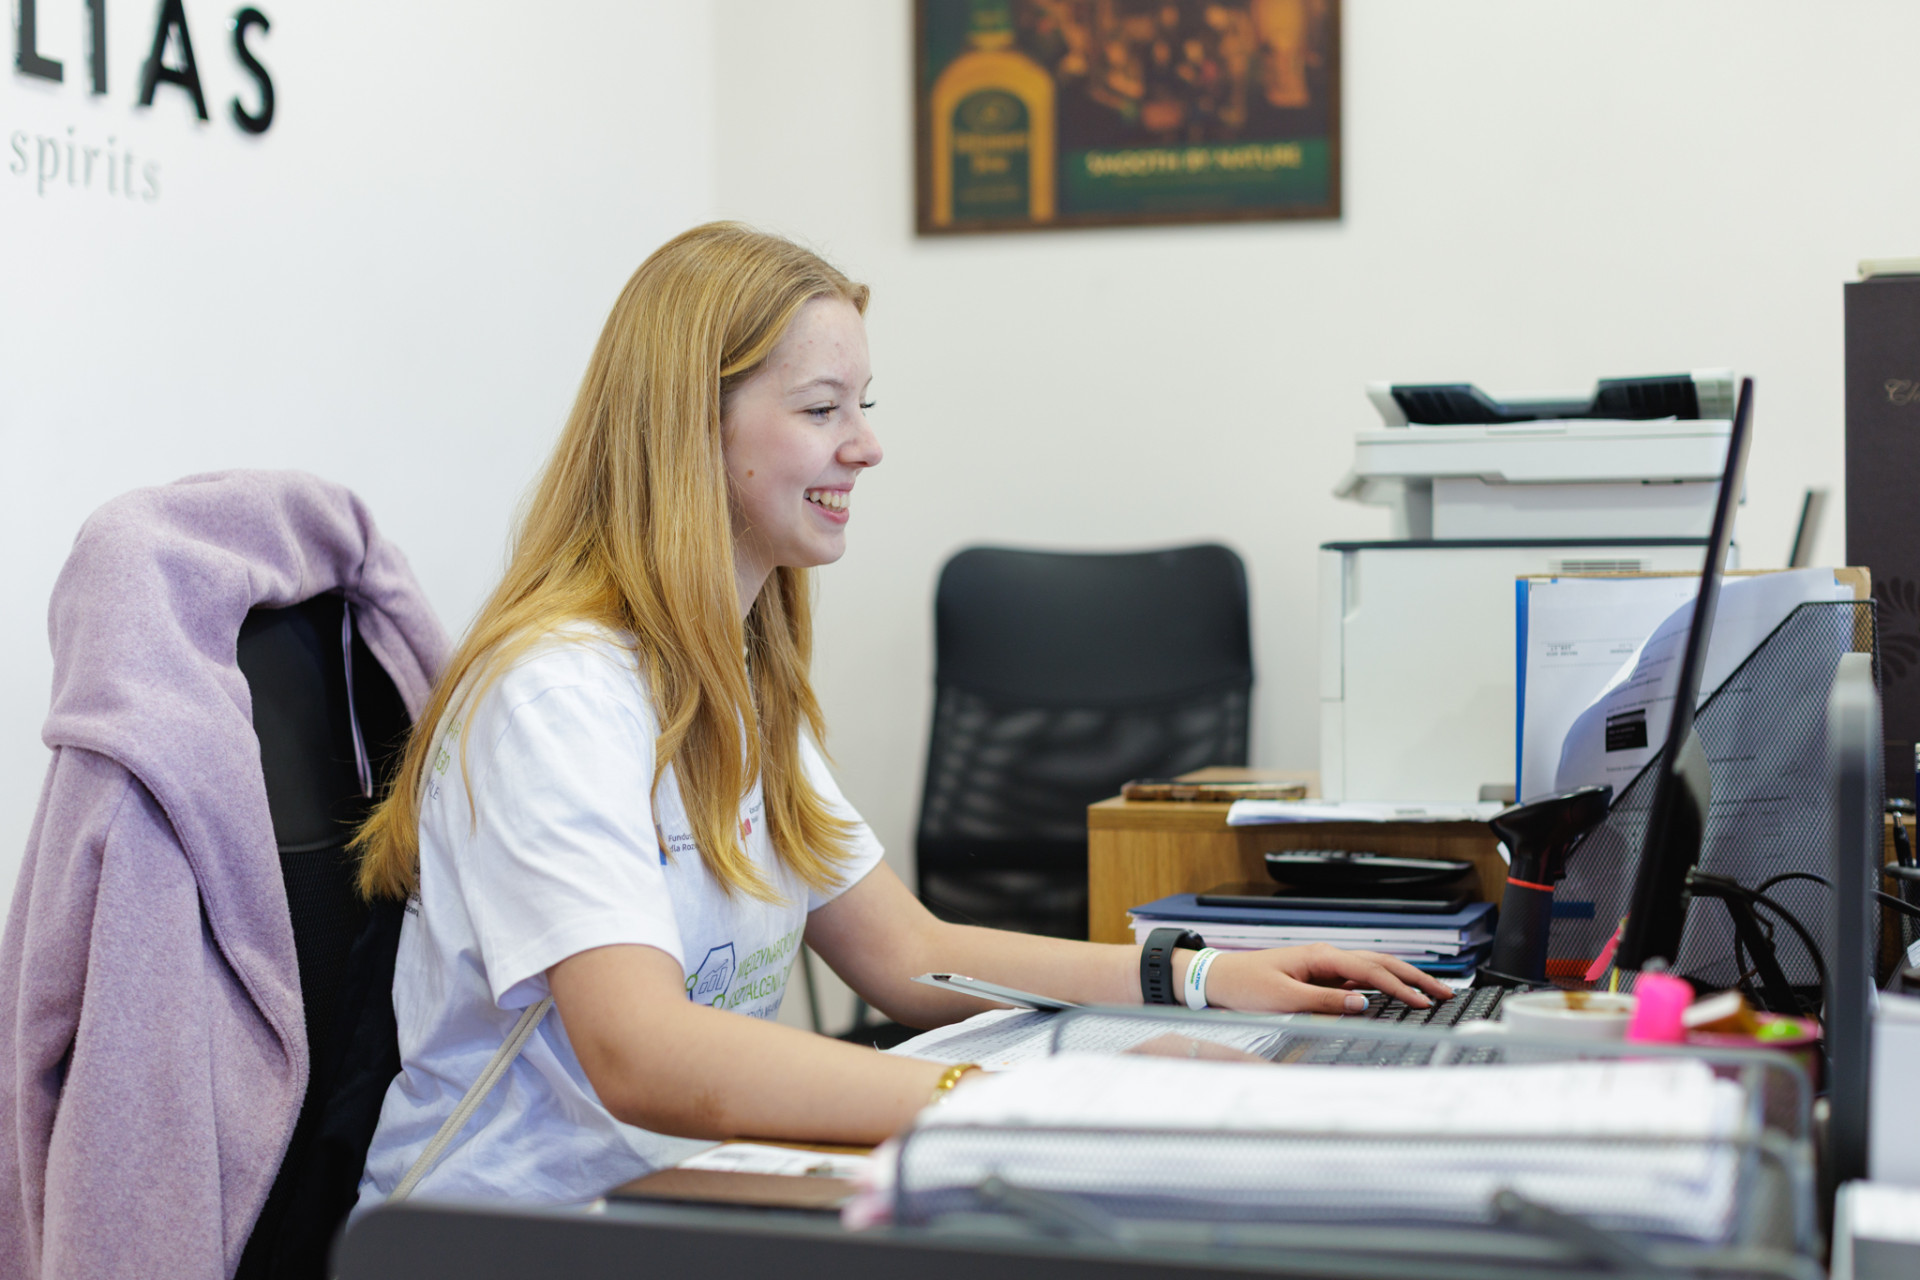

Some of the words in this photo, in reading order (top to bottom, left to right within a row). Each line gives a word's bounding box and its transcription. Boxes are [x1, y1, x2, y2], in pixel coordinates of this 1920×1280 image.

[9, 126, 161, 203] spirits
[1086, 150, 1177, 178] SMOOTH
[1214, 143, 1302, 170] NATURE
